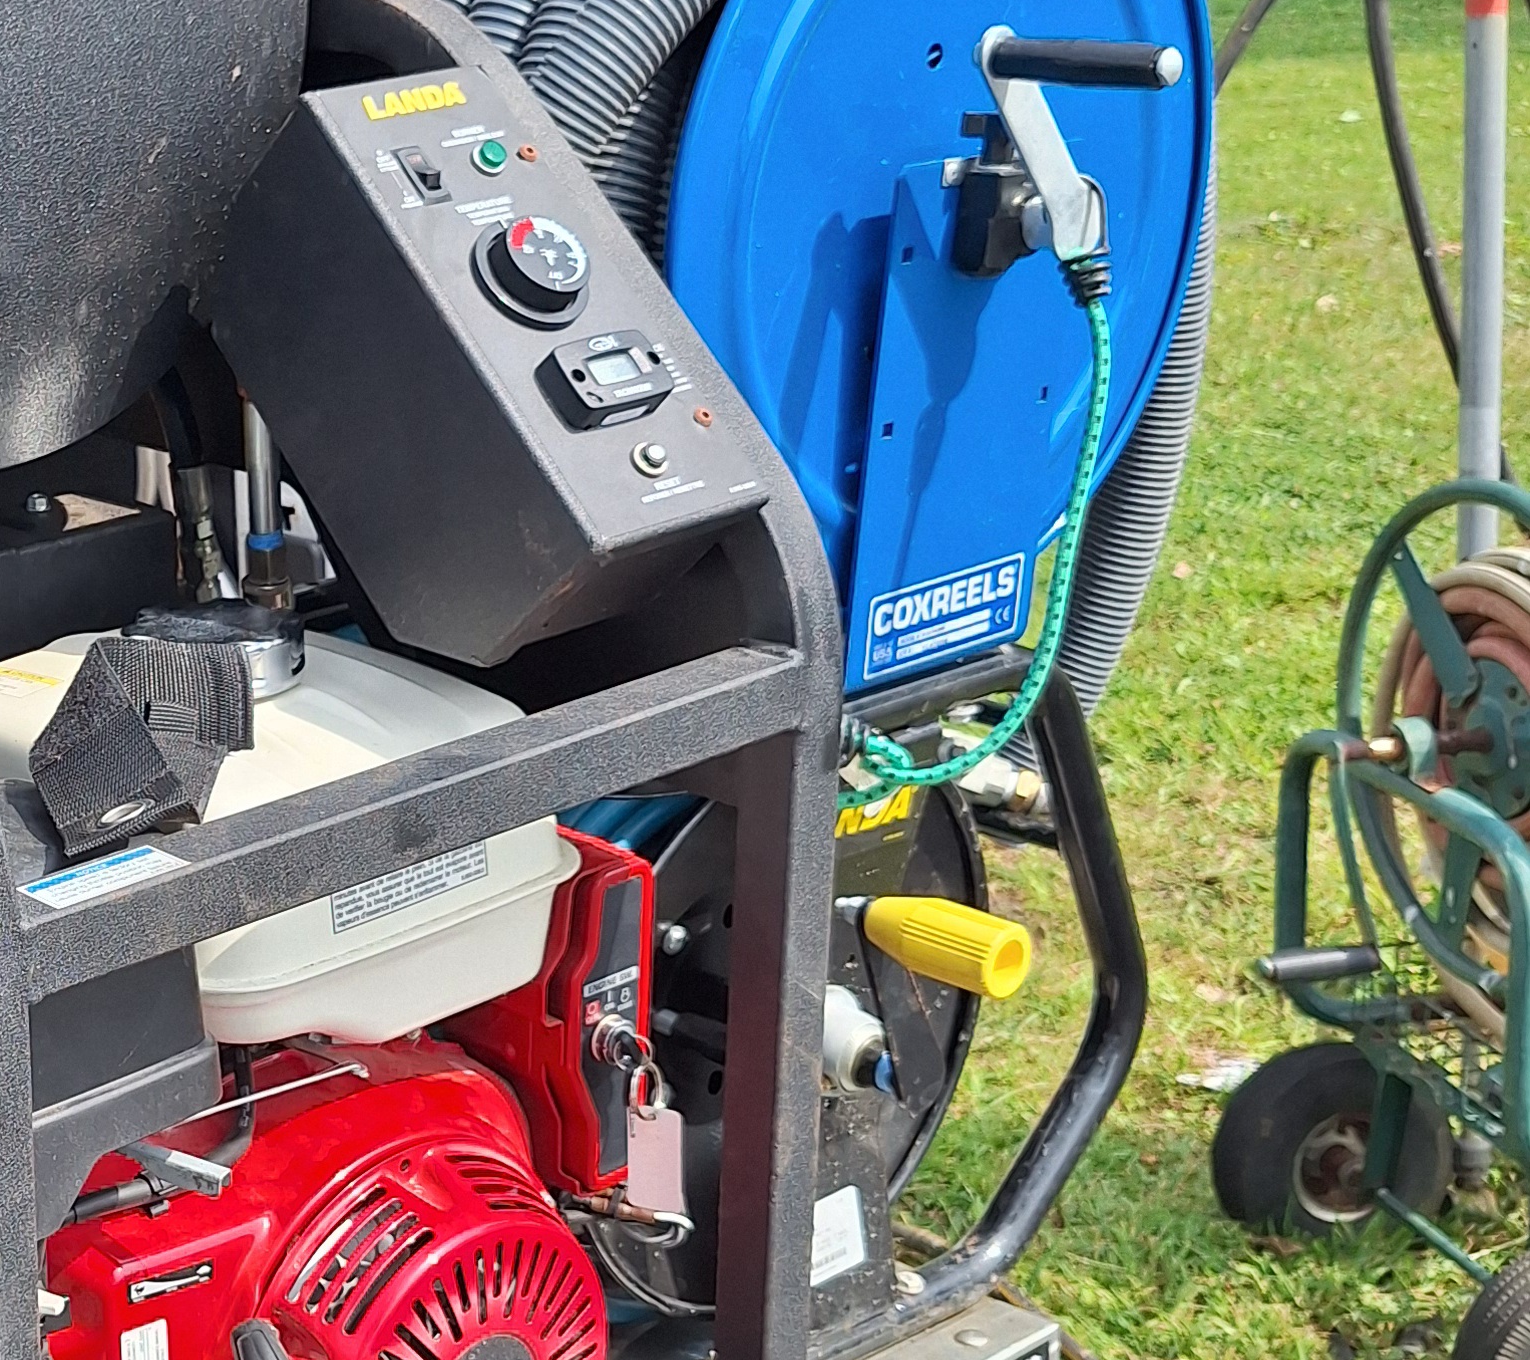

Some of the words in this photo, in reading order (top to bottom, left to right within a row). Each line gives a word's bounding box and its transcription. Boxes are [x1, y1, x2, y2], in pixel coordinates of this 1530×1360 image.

[361, 80, 468, 121] LANDA
[873, 563, 1017, 637] COXREELS
[834, 784, 920, 840] NDA
